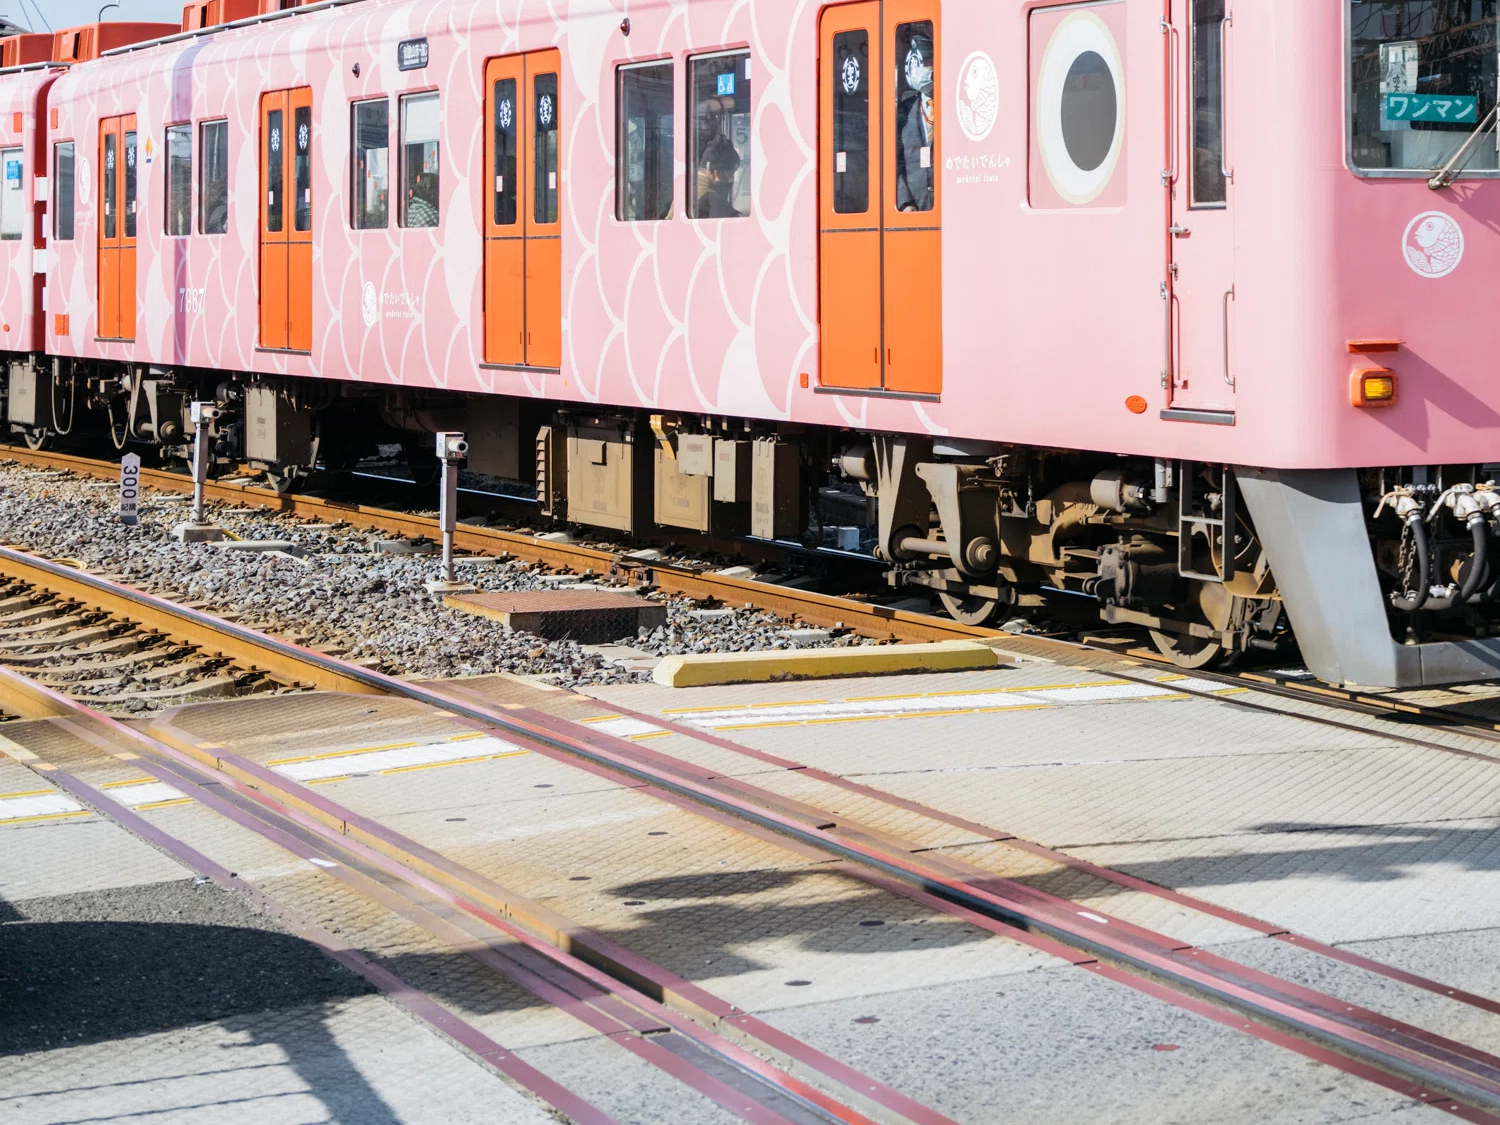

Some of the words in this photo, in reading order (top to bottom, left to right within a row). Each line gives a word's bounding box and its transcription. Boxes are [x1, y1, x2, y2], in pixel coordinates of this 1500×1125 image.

[1389, 96, 1475, 120] ワンマン
[945, 153, 1011, 171] めでたいでんしゃ
[122, 465, 138, 499] 300
